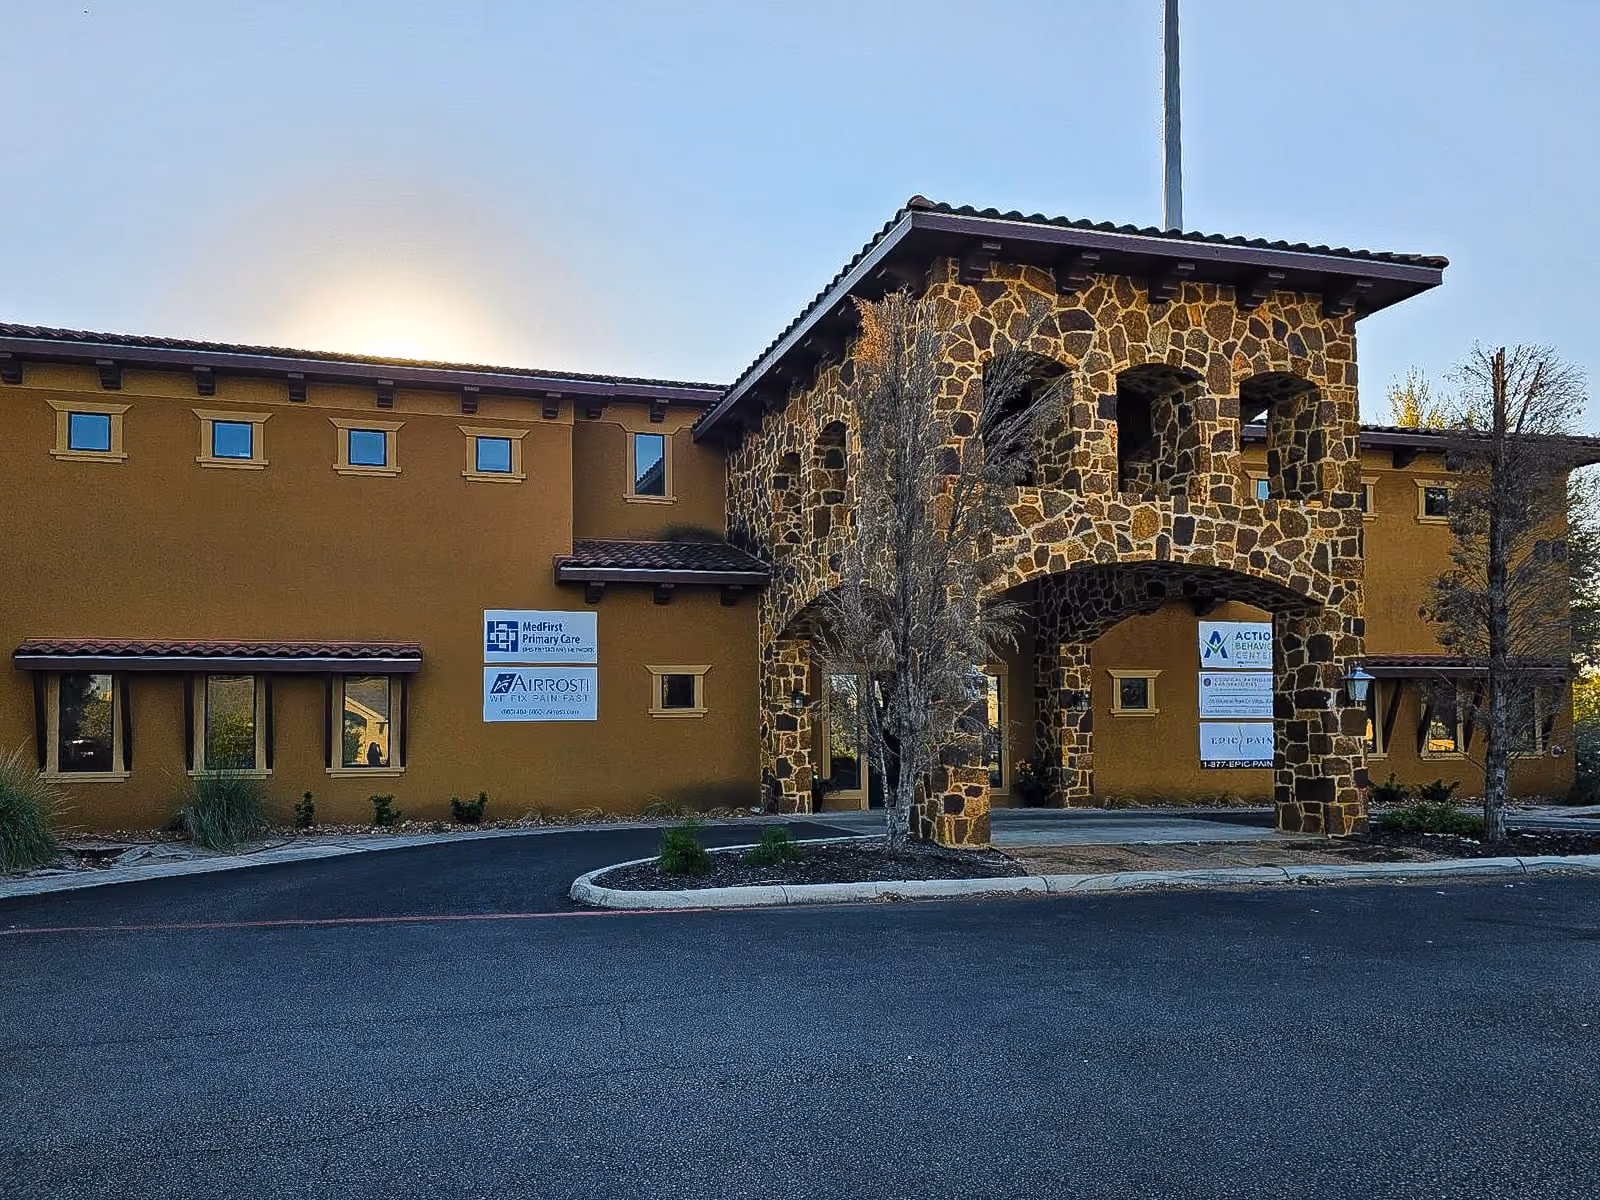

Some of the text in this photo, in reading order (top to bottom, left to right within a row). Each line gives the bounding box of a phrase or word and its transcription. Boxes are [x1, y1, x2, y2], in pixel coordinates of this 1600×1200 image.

[522, 622, 563, 632] MedFirst
[522, 633, 581, 646] Primary Care
[1235, 631, 1271, 641] ACTIO
[1235, 642, 1272, 651] BEHAVIO
[512, 674, 590, 692] AIRROSTI
[510, 694, 528, 703] FIX
[532, 694, 558, 703] PAIN
[563, 694, 588, 703] FAST
